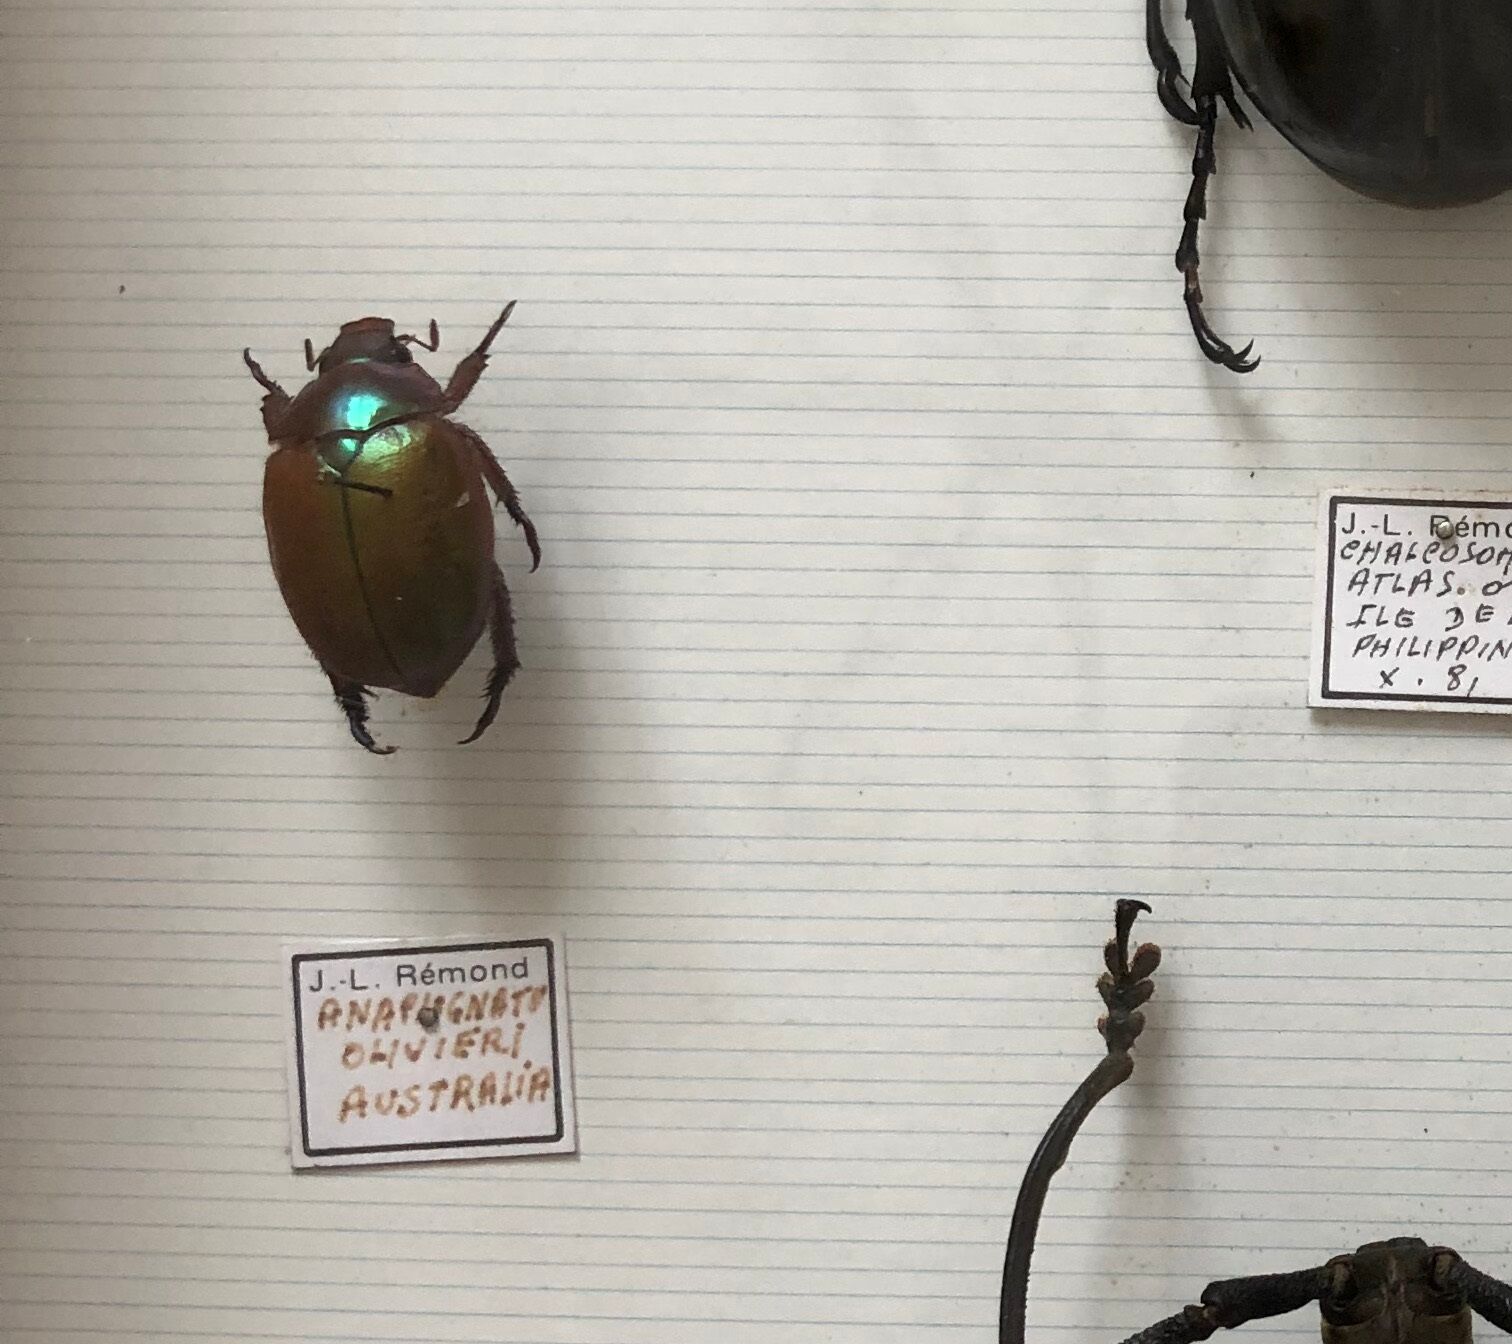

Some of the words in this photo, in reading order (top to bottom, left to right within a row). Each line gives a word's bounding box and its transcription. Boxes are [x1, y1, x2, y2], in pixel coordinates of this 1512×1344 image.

[1342, 512, 1413, 536] J.-L.
[1346, 604, 1415, 628] ILE
[1445, 604, 1494, 631] DE
[309, 969, 381, 992] J.-L.
[397, 957, 529, 986] Rémond
